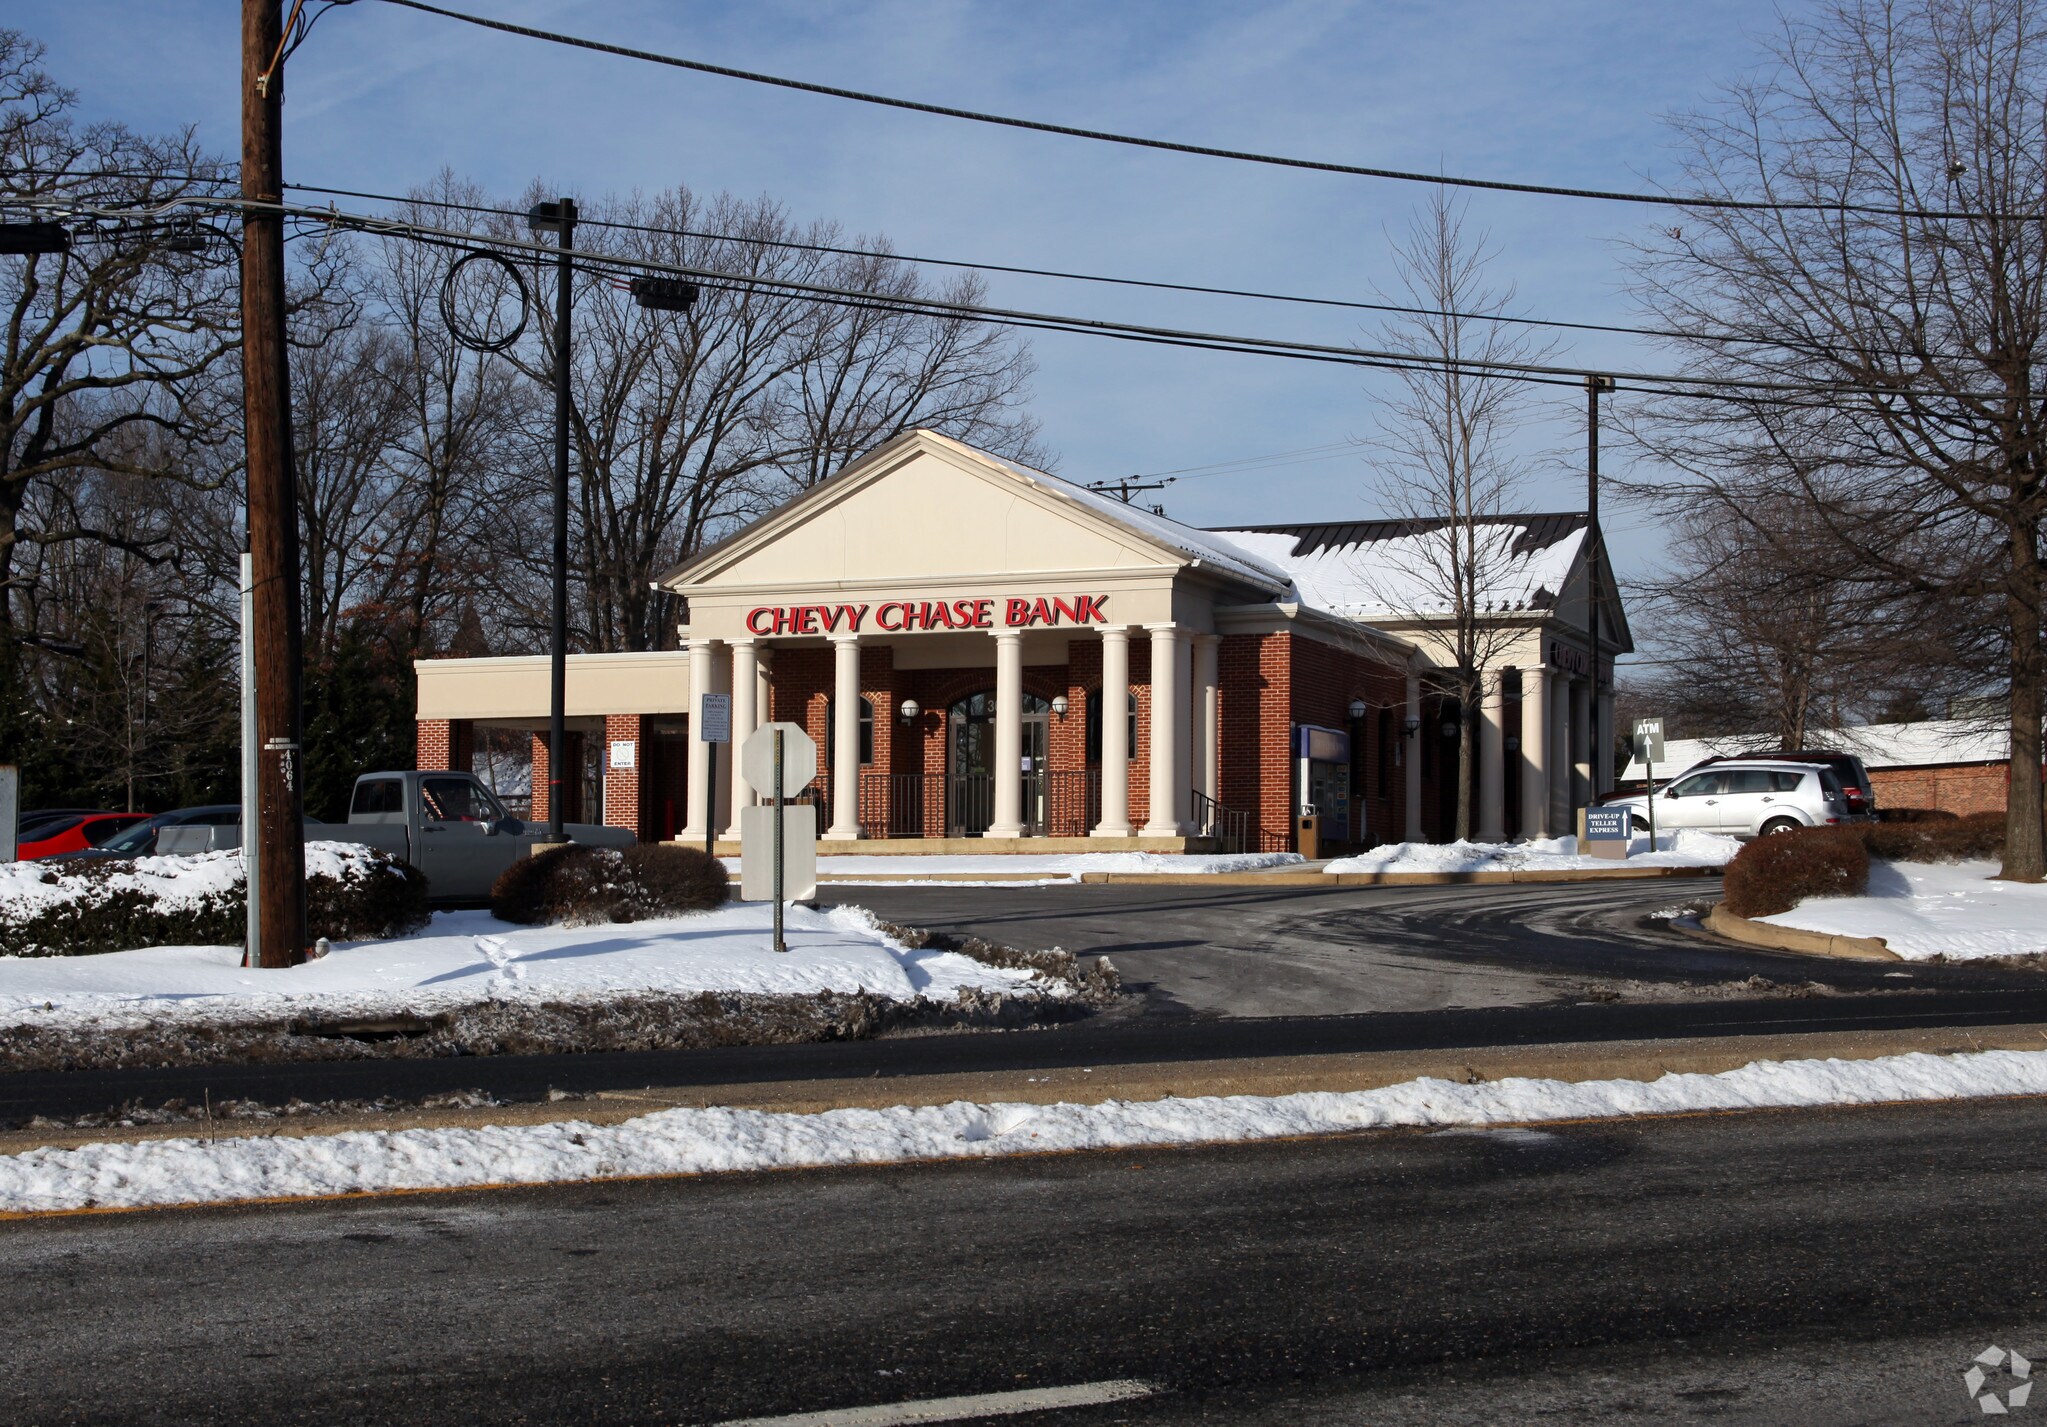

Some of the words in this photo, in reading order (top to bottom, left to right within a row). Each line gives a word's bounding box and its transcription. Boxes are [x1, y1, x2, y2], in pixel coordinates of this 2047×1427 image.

[745, 604, 868, 635] CHEVY
[875, 599, 993, 631] CHASE
[1005, 594, 1109, 626] BANK
[1637, 722, 1659, 735] ATM
[285, 749, 293, 791] 4064
